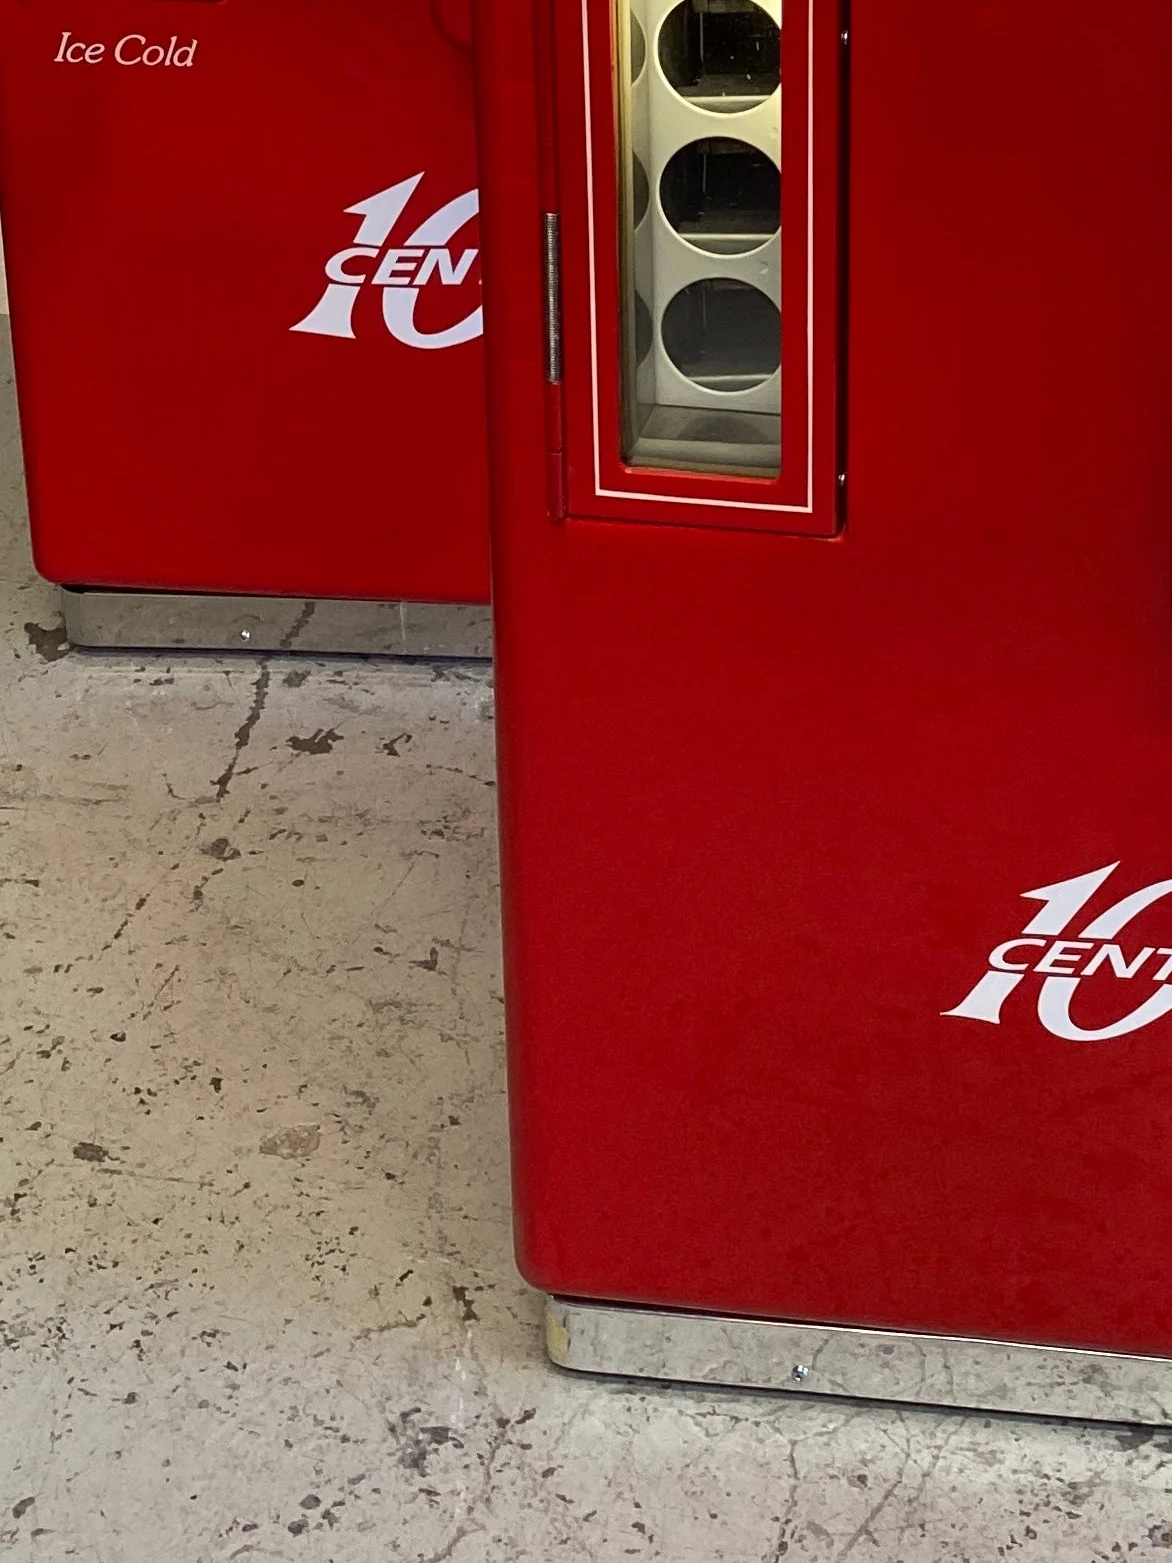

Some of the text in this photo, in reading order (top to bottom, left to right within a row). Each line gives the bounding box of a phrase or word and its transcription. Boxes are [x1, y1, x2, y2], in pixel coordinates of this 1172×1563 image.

[54, 31, 197, 67] Ice Cold
[325, 247, 482, 285] CEN
